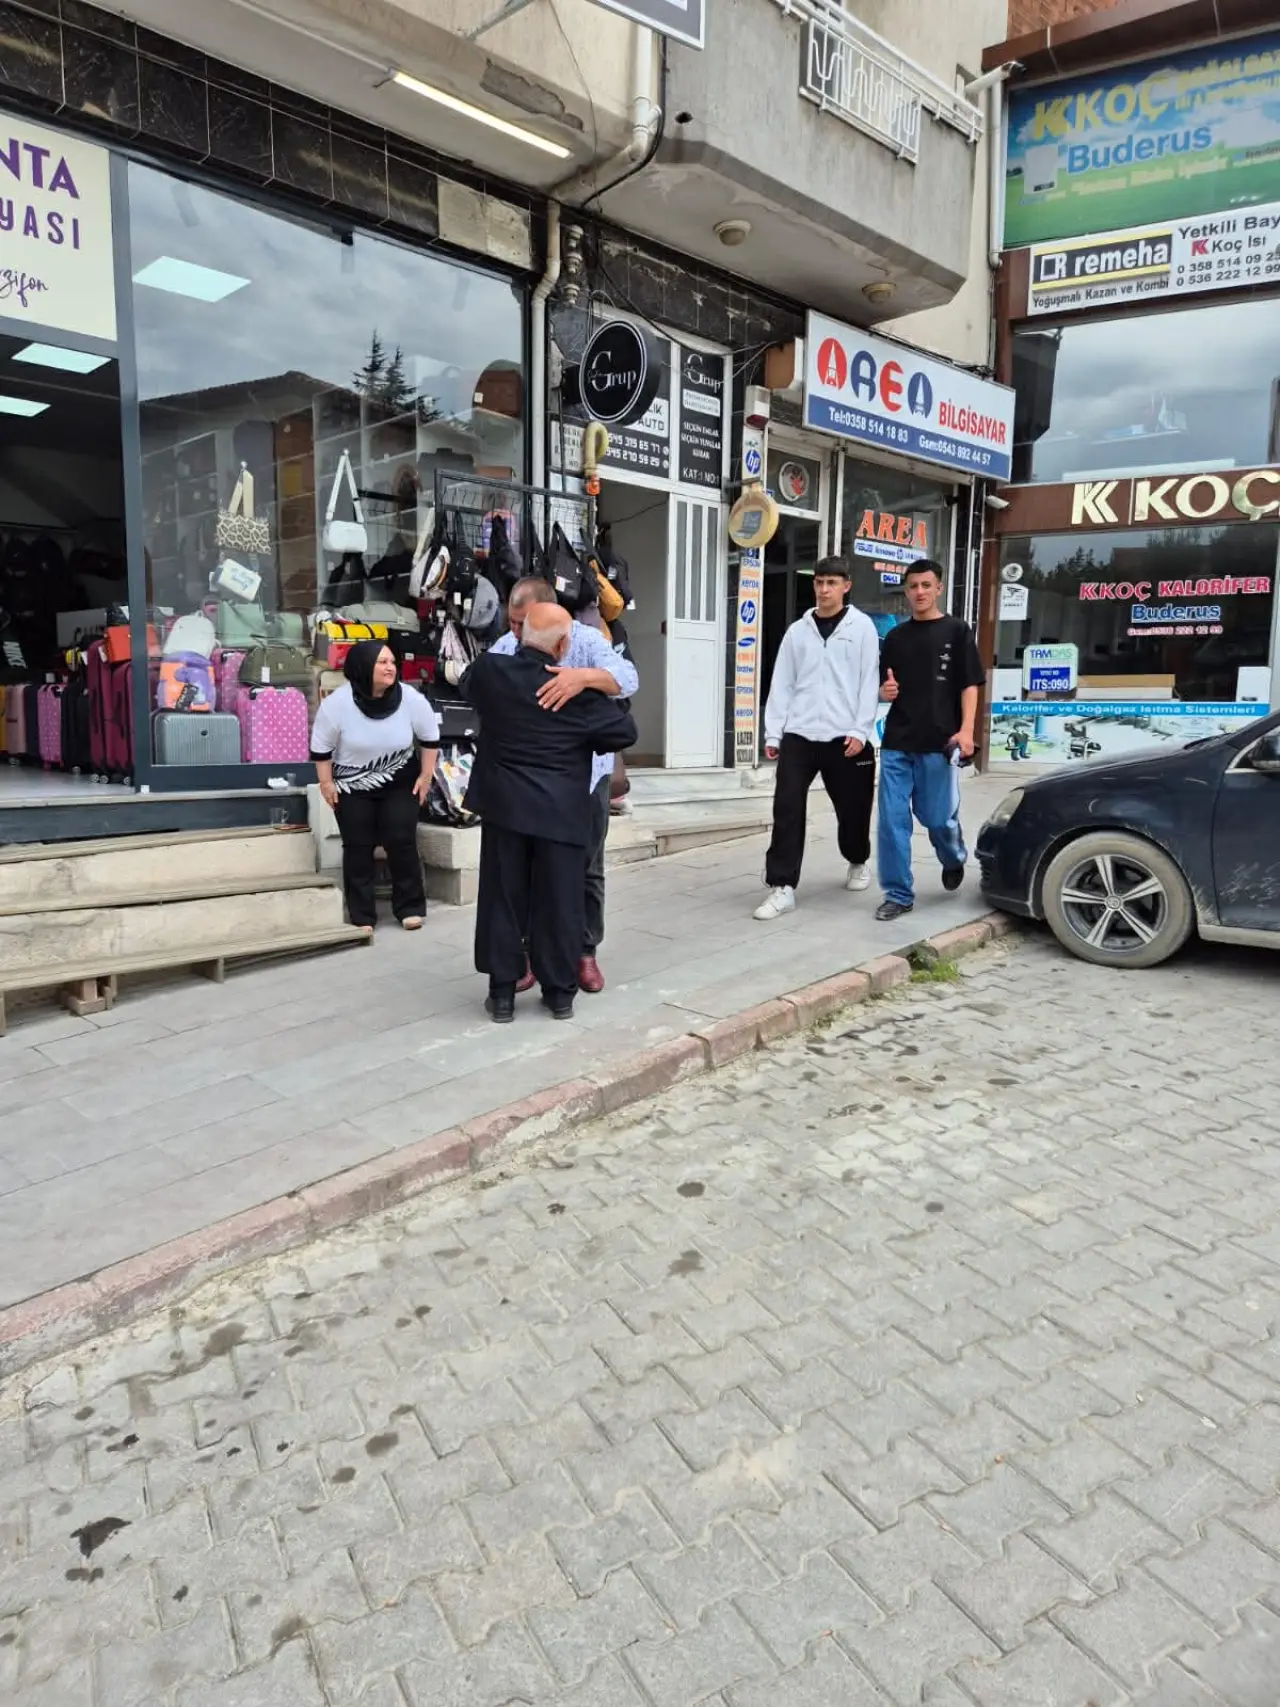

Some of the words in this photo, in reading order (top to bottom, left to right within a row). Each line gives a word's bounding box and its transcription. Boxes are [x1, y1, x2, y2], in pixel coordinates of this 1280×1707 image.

[1067, 126, 1212, 174] Buderus
[1178, 219, 1236, 239] Yetkili
[1074, 240, 1169, 276] remeha
[1212, 239, 1242, 253] Koç
[1176, 277, 1184, 286] 0
[1188, 273, 1211, 284] 536
[1216, 269, 1240, 281] 222
[1246, 266, 1260, 276] 12
[1177, 265, 1185, 273] 0
[1189, 261, 1212, 272] 358
[1217, 257, 1241, 268] 514
[1245, 253, 1262, 264] 09
[1033, 293, 1081, 308] Yoğuşmalı
[1085, 286, 1117, 300] Kazan
[1120, 283, 1133, 294] ve
[1136, 277, 1169, 292] Kombi
[590, 351, 636, 391] Grup
[817, 337, 933, 419] AREA
[829, 406, 866, 430] Tel:0358
[868, 422, 884, 436] 514
[886, 426, 896, 440] 18
[938, 398, 1007, 445] BİLGİSAYAR
[745, 450, 760, 473] hp
[1134, 470, 1280, 522] KOÇ
[856, 509, 927, 550] AREA
[1158, 575, 1270, 597] KALORİFER
[741, 601, 756, 623] hp
[1131, 604, 1220, 622] Buderus
[1002, 704, 1053, 712] Kalorifer
[1076, 704, 1136, 714] Doğalgaz
[1185, 705, 1256, 713] Sistemleri
